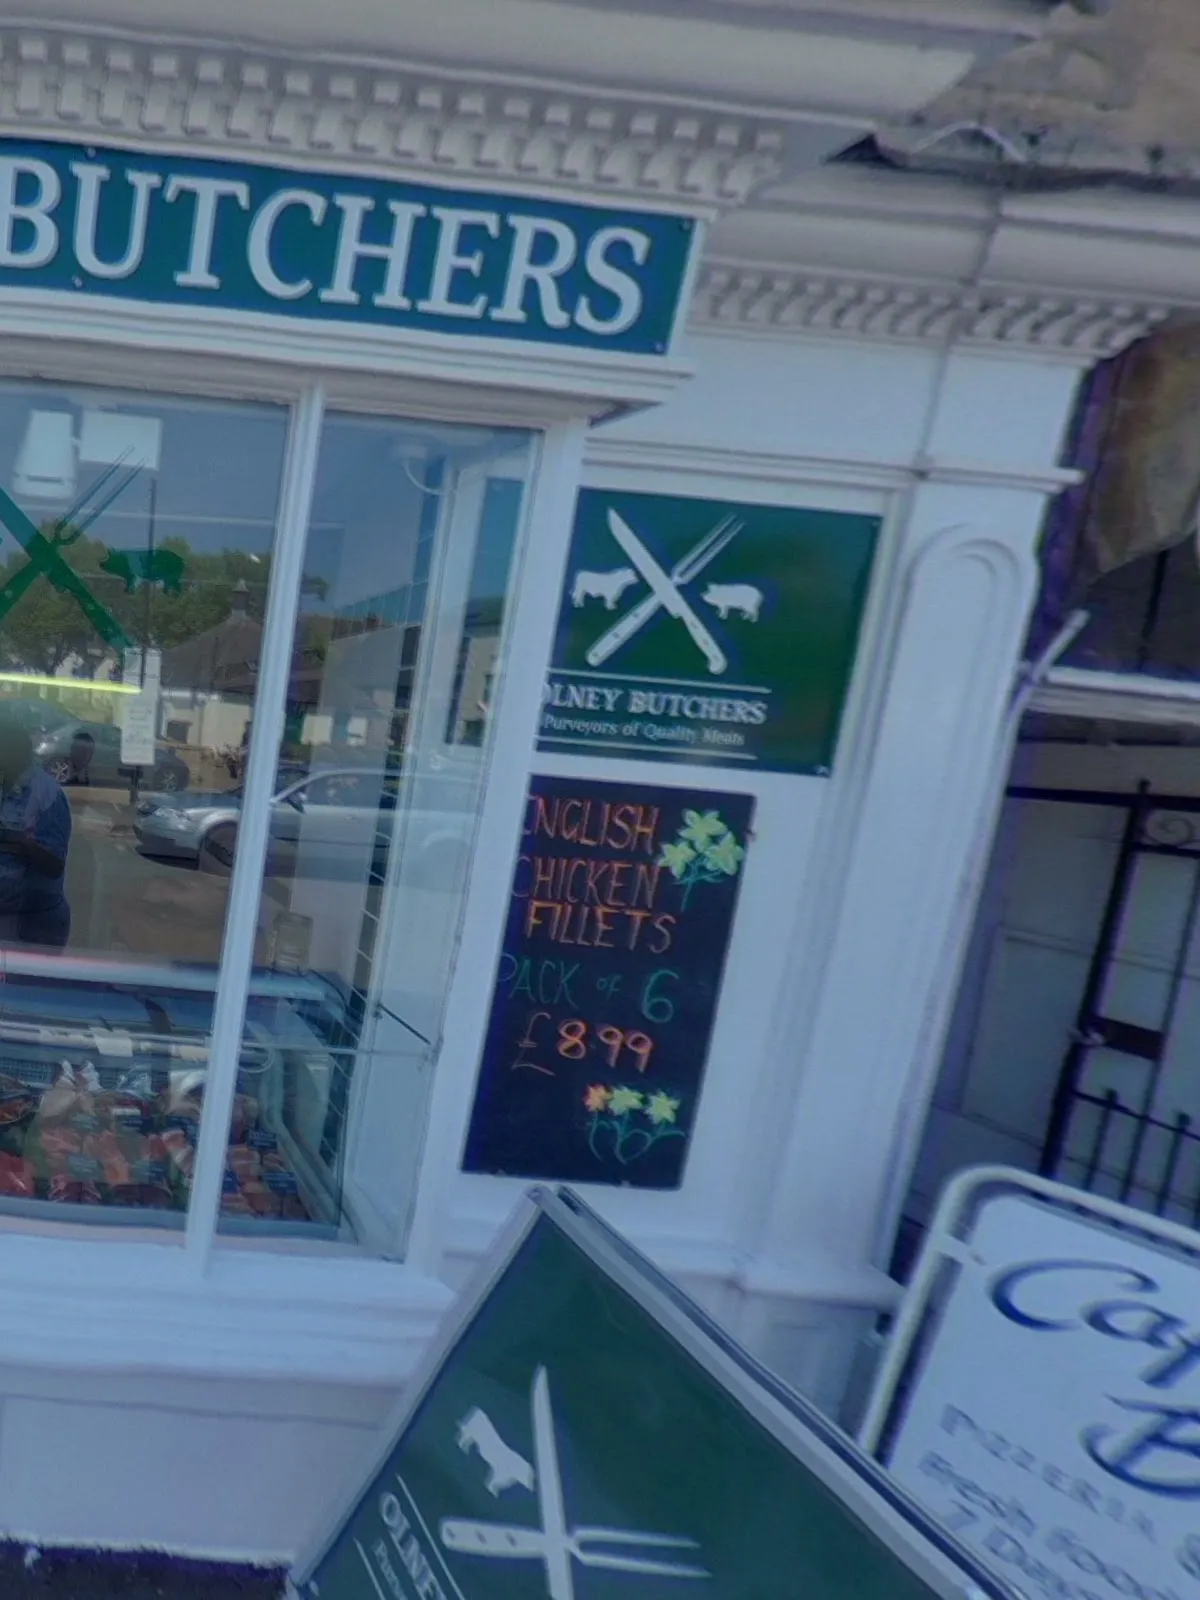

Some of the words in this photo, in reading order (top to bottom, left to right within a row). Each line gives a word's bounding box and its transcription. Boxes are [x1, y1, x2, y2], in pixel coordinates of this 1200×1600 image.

[627, 689, 768, 725] BUTCHERS
[544, 714, 618, 737] Purveyors
[622, 722, 642, 737] of
[702, 726, 746, 747] Meats
[526, 901, 677, 954] FILLETS
[643, 968, 680, 1024] 6
